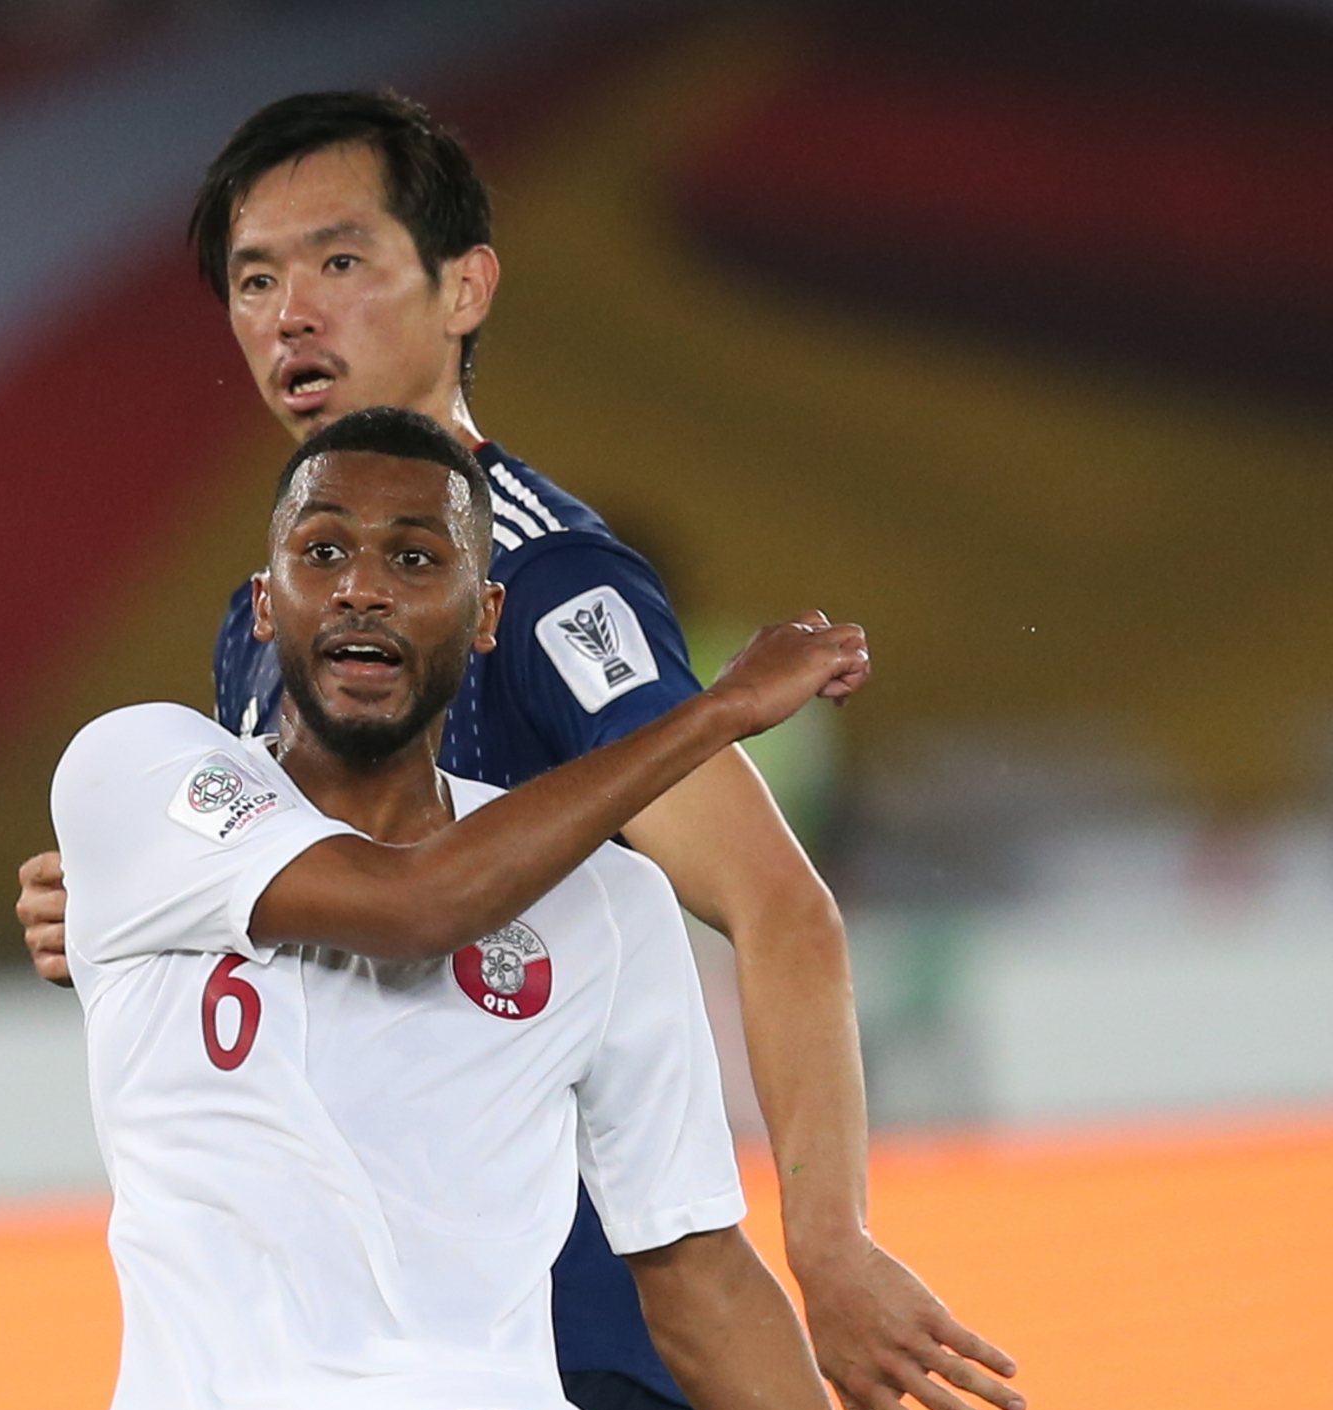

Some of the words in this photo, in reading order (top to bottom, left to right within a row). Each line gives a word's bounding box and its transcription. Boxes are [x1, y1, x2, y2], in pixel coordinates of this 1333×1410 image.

[219, 802, 255, 839] ASIAN
[236, 813, 253, 830] UAE
[202, 953, 262, 1072] 6
[483, 993, 521, 1015] QFA
